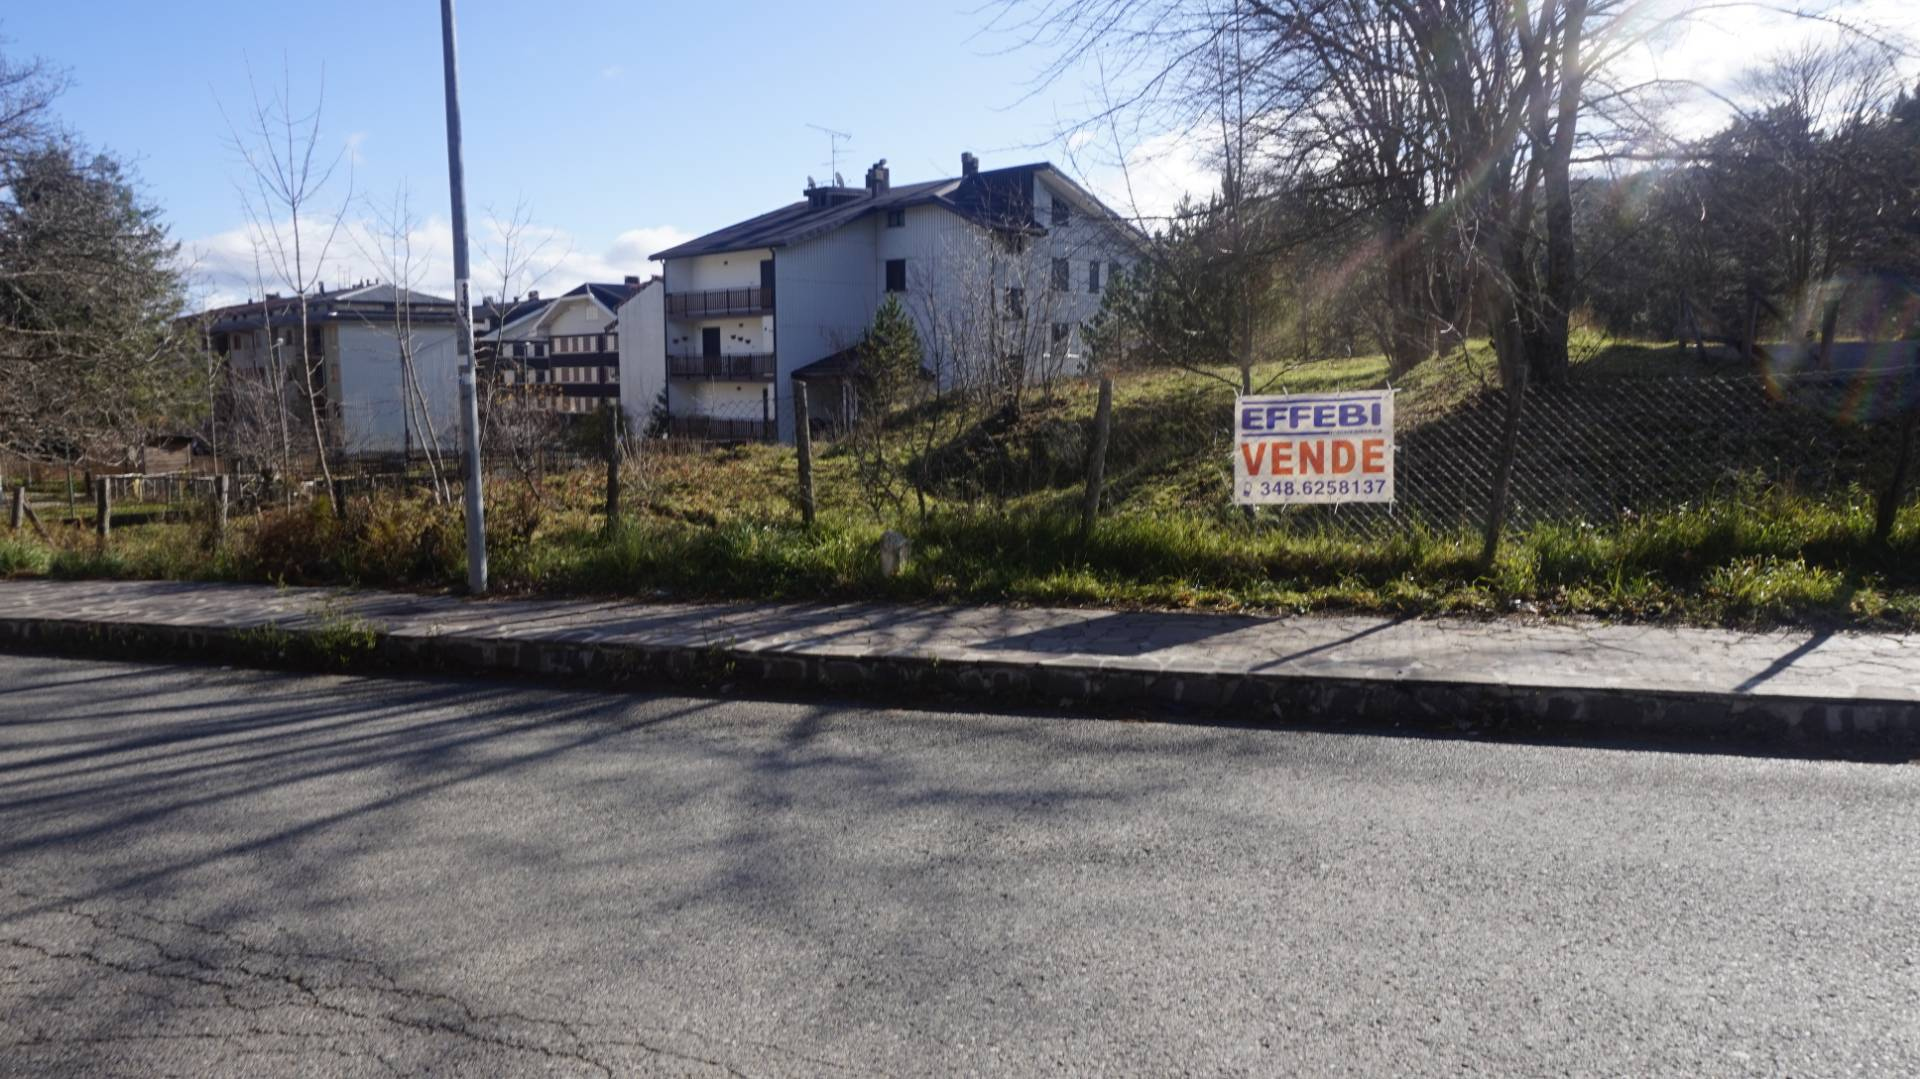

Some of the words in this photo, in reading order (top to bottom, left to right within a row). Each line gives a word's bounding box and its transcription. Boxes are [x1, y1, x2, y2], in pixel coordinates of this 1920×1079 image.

[1241, 403, 1382, 430] EFFEBI
[1241, 439, 1386, 476] VENDE
[1260, 480, 1387, 496] 348.6258137
